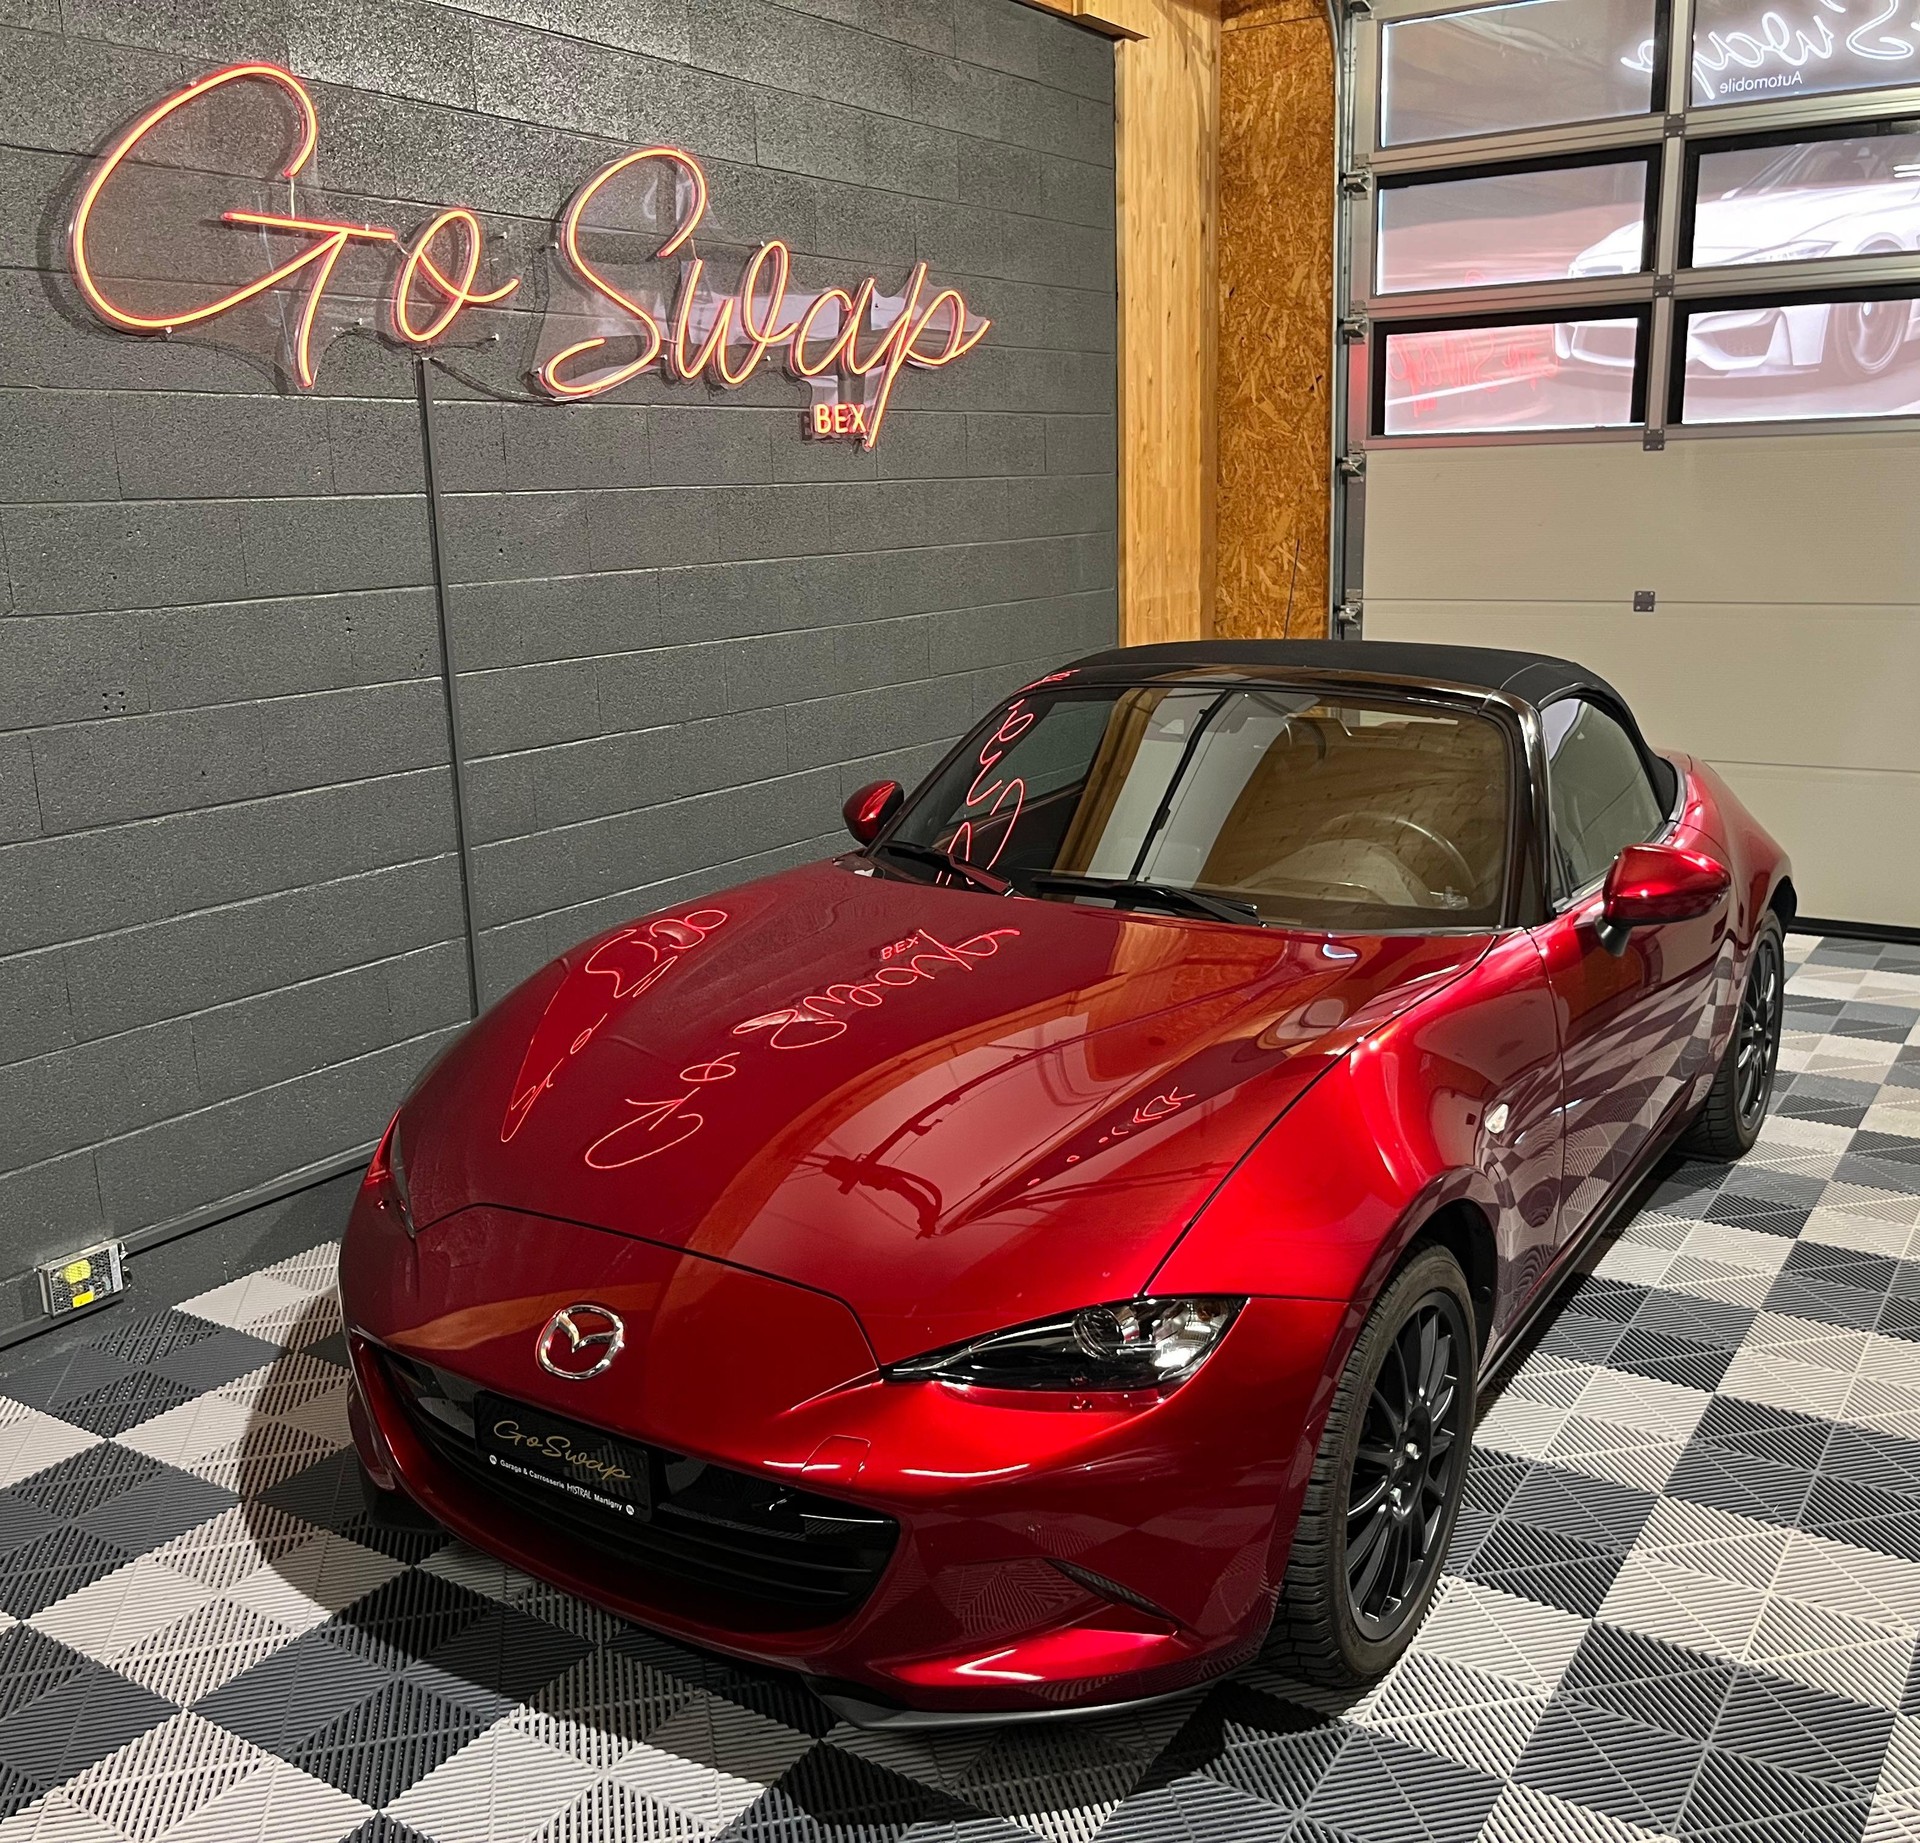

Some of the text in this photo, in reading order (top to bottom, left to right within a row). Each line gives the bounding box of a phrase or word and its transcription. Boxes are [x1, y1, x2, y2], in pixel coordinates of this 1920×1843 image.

[72, 61, 992, 451] Go Swap
[814, 403, 867, 434] BEX
[500, 1459, 522, 1474] Garage
[528, 1470, 565, 1490] Carrosserie
[593, 1493, 623, 1511] Martigny
